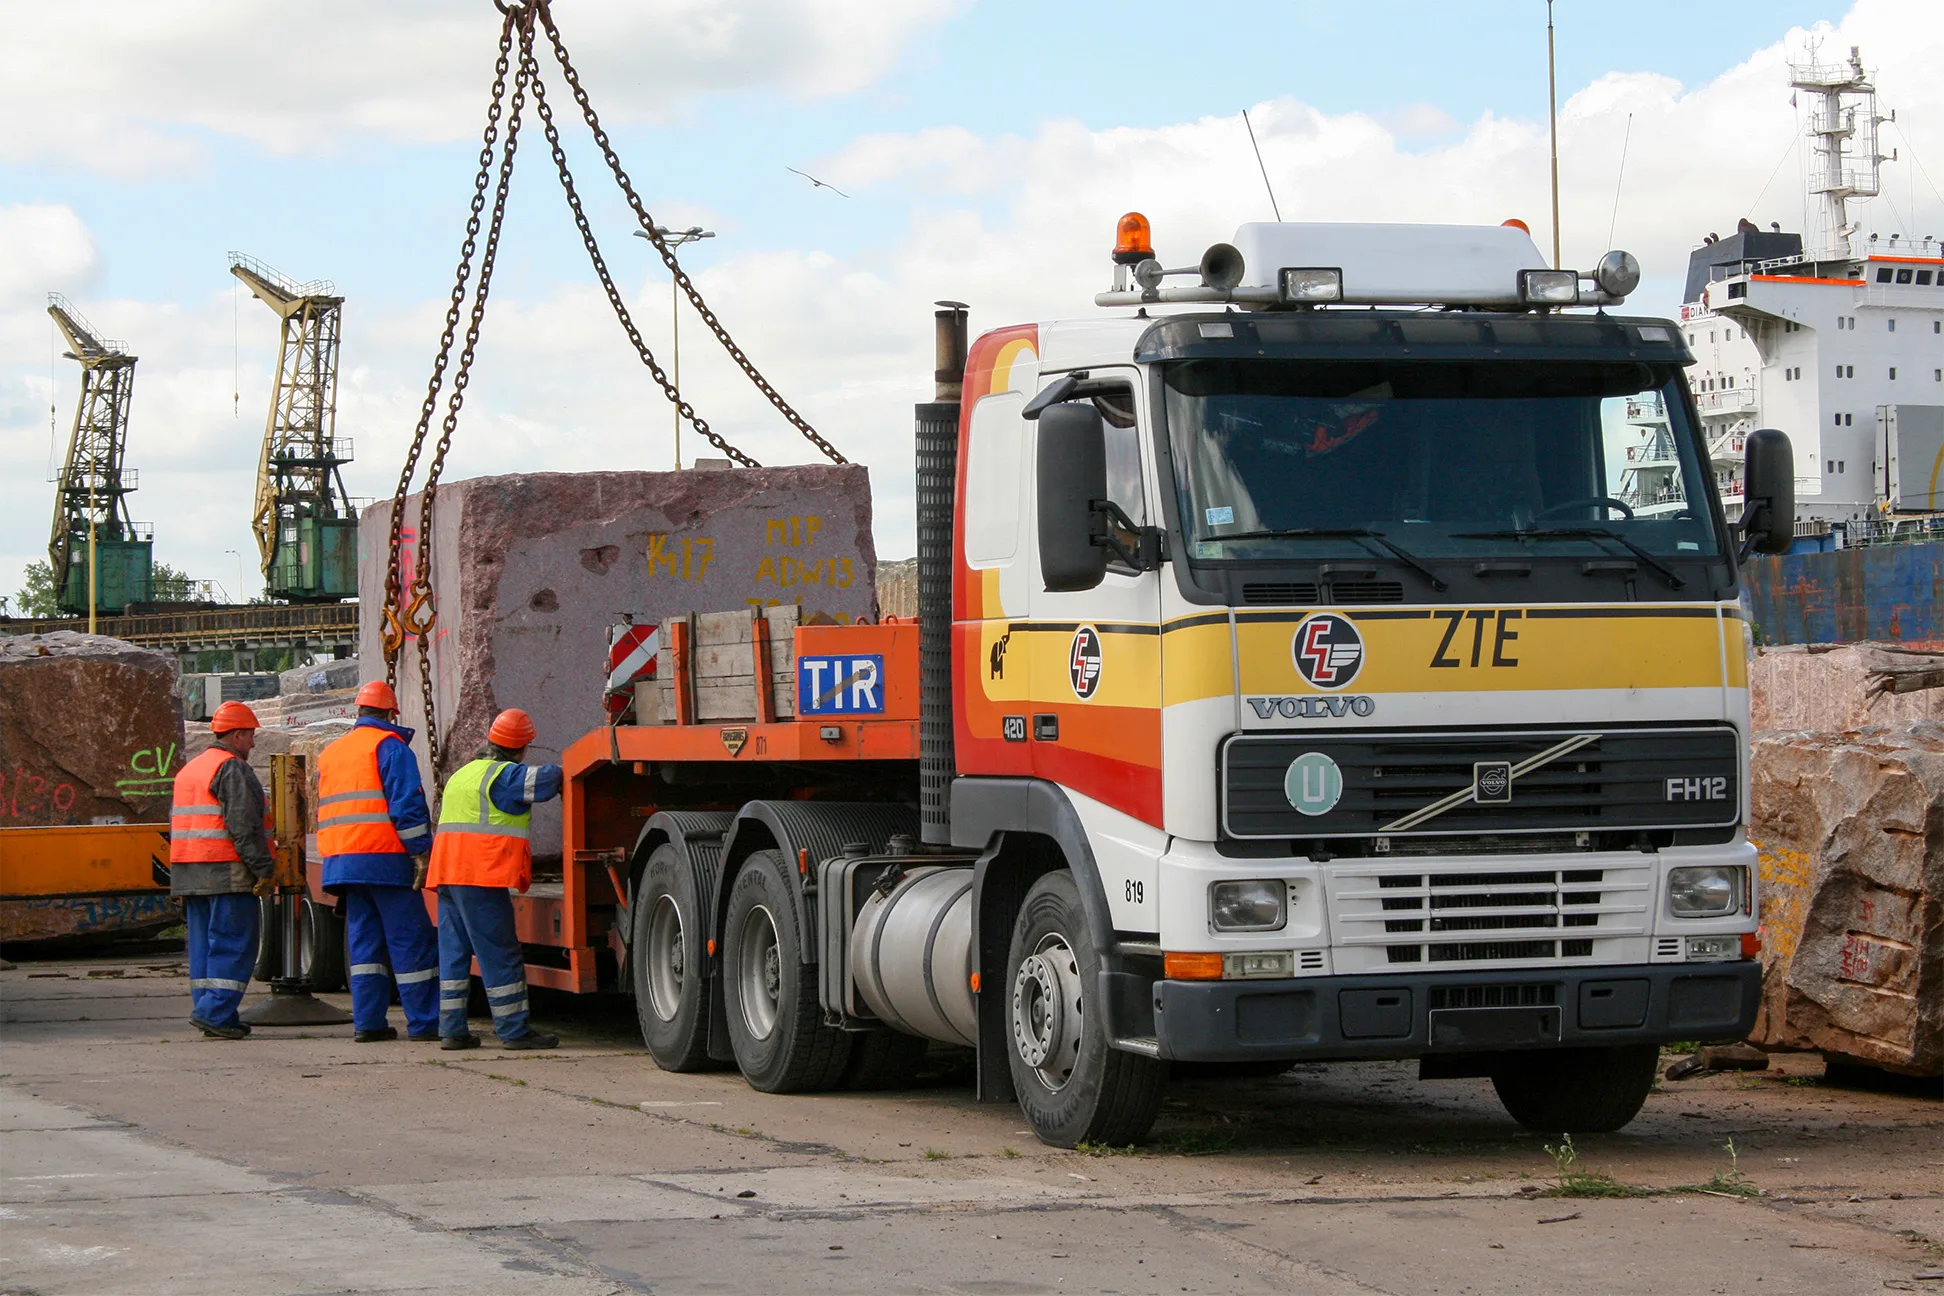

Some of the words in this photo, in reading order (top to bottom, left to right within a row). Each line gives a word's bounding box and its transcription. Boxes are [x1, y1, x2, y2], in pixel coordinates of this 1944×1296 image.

[1430, 609, 1519, 668] ZTE
[803, 659, 877, 709] TIR
[1247, 696, 1375, 718] VOLVO
[1004, 718, 1024, 739] 420
[131, 742, 177, 777] CV
[1303, 766, 1325, 802] U
[1666, 777, 1727, 800] FH12
[1125, 879, 1143, 904] 819
